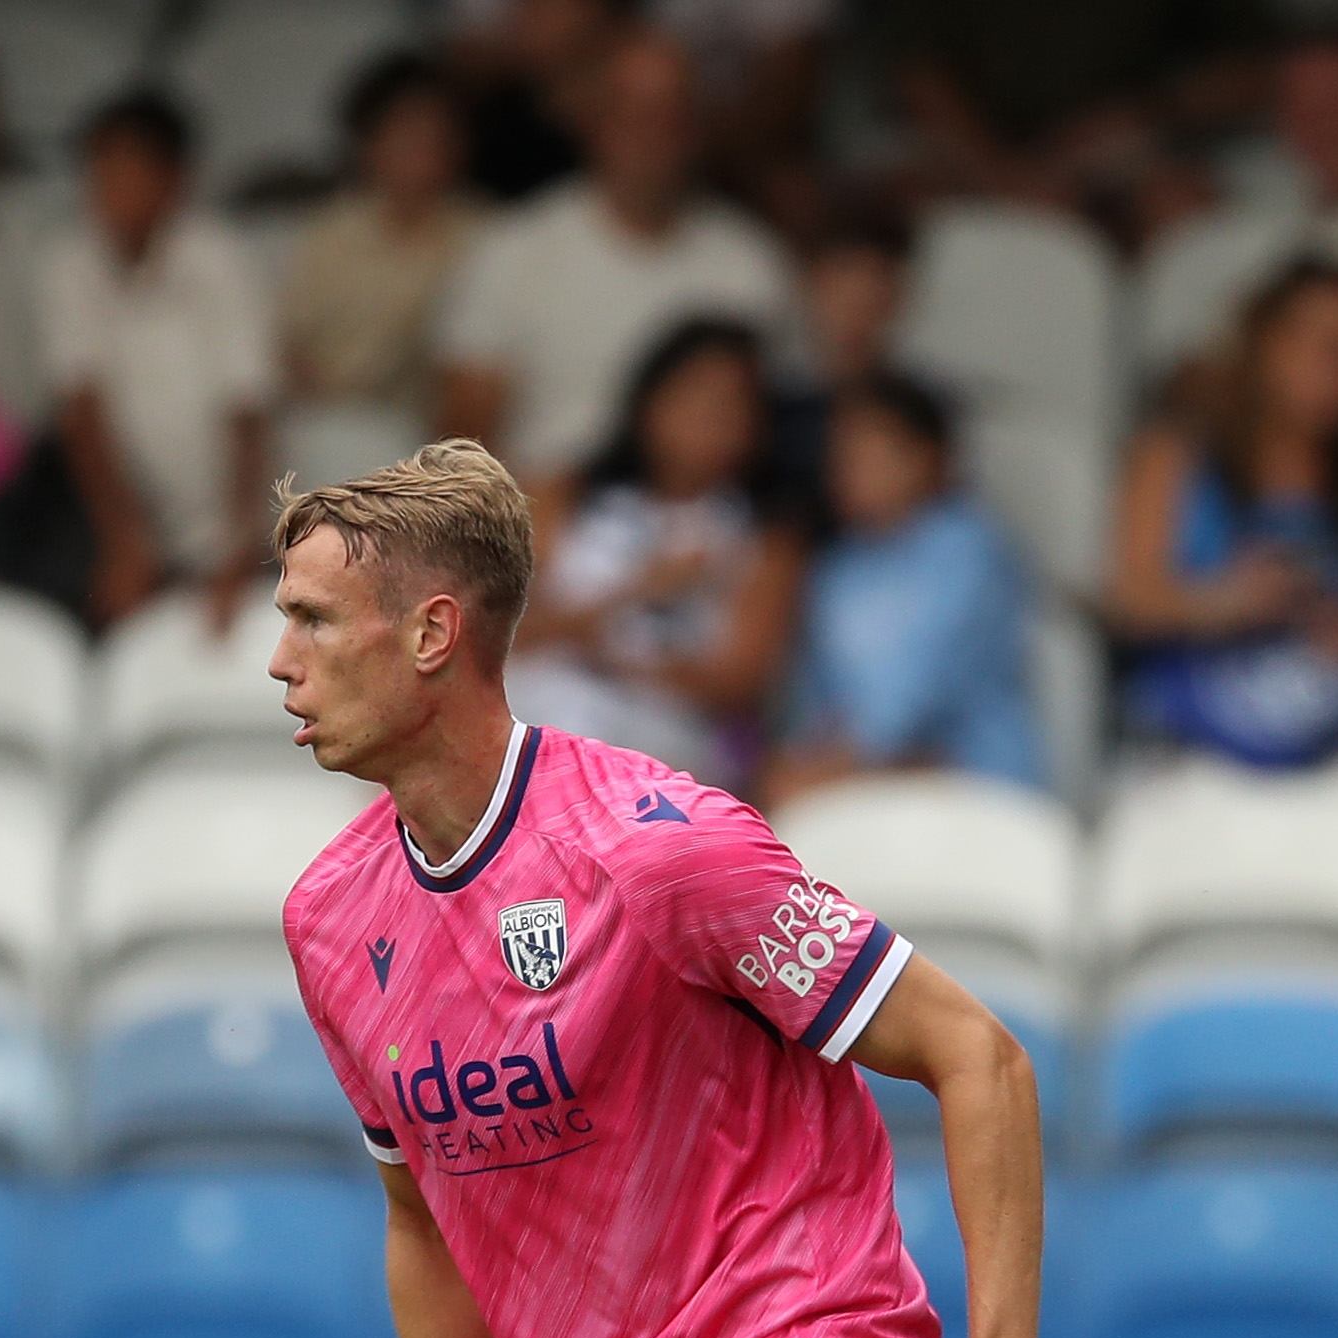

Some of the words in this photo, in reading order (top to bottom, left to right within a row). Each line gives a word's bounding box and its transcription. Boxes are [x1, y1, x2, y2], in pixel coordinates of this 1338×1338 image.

[504, 912, 559, 934] ALBION
[776, 893, 860, 998] BOSS
[387, 1022, 577, 1124] ideal
[417, 1107, 594, 1161] HEATING
